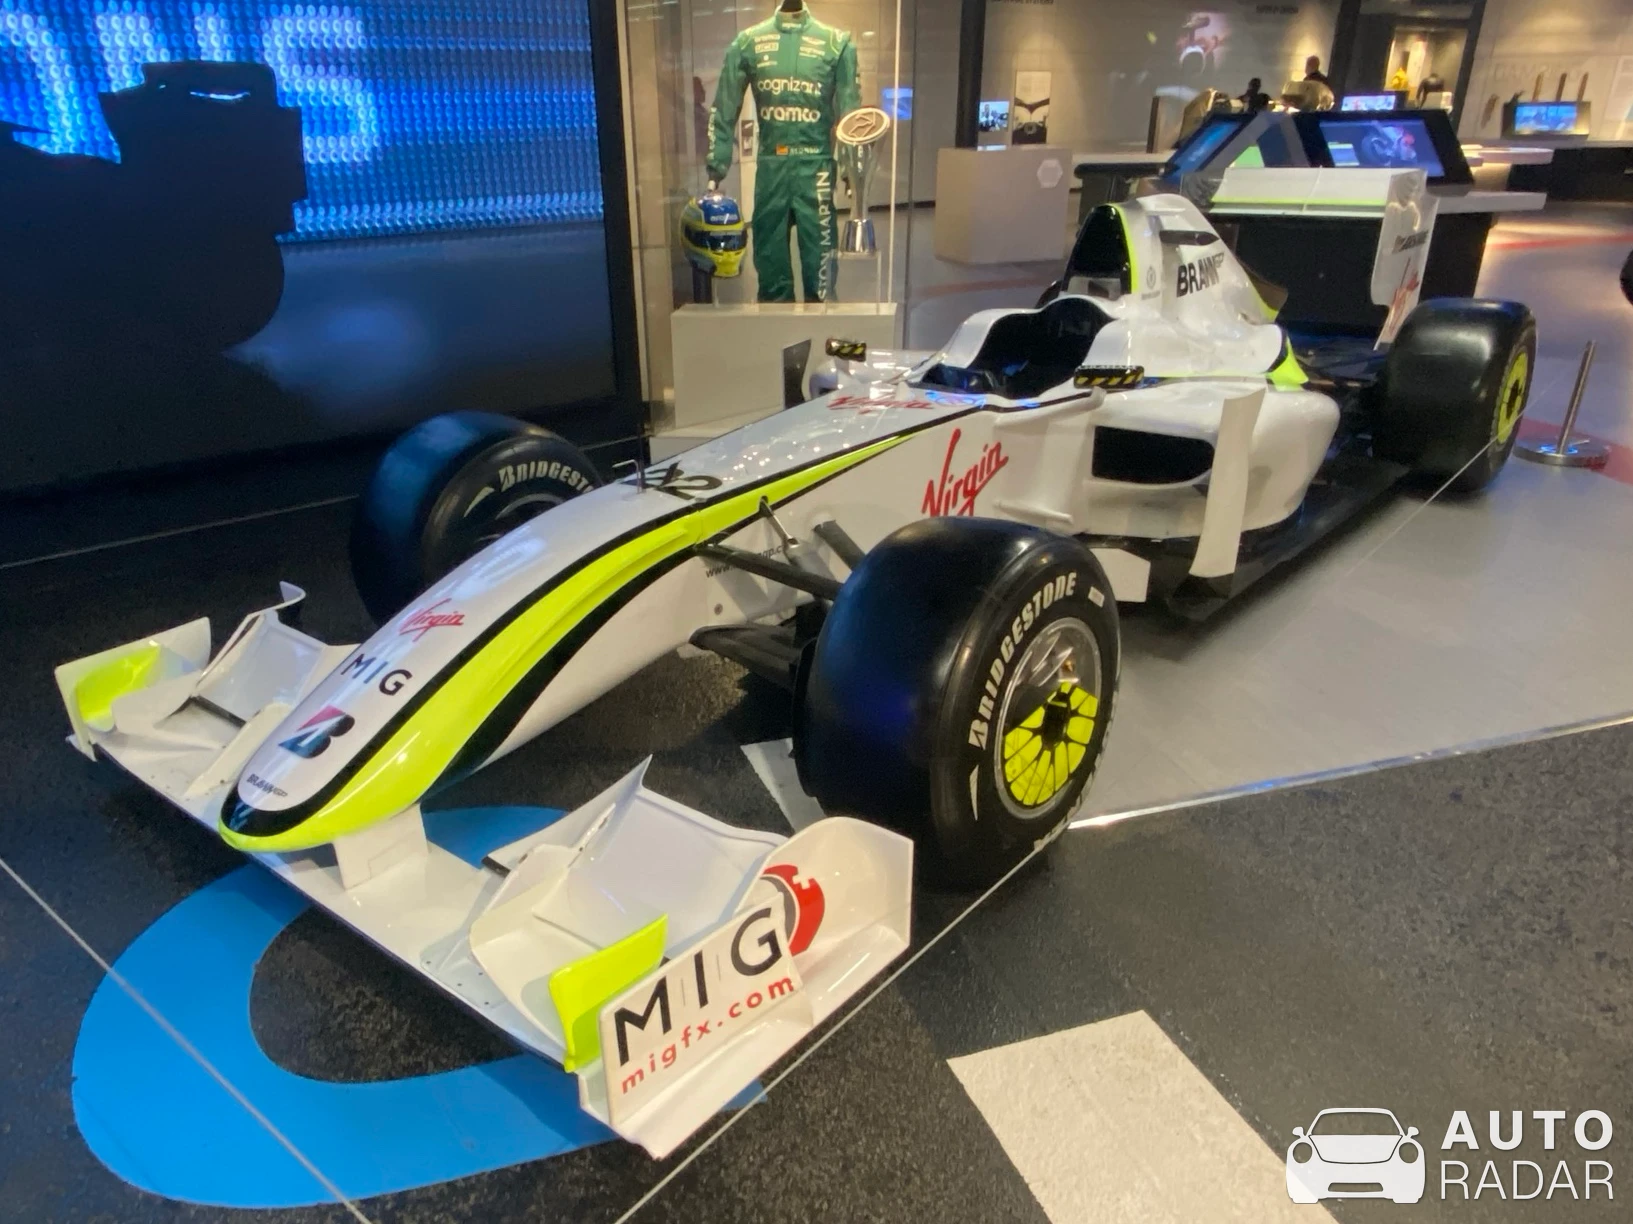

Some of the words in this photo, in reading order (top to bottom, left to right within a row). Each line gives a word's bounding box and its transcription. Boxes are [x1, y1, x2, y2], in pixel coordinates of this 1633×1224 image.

[761, 106, 821, 122] aramco
[816, 171, 832, 246] MARTIN
[921, 428, 1009, 517] Virgin
[399, 598, 465, 642] Virgin
[340, 653, 413, 696] MIG
[968, 572, 1078, 750] BRIDGESTONE
[622, 976, 794, 1094] migfx.com
